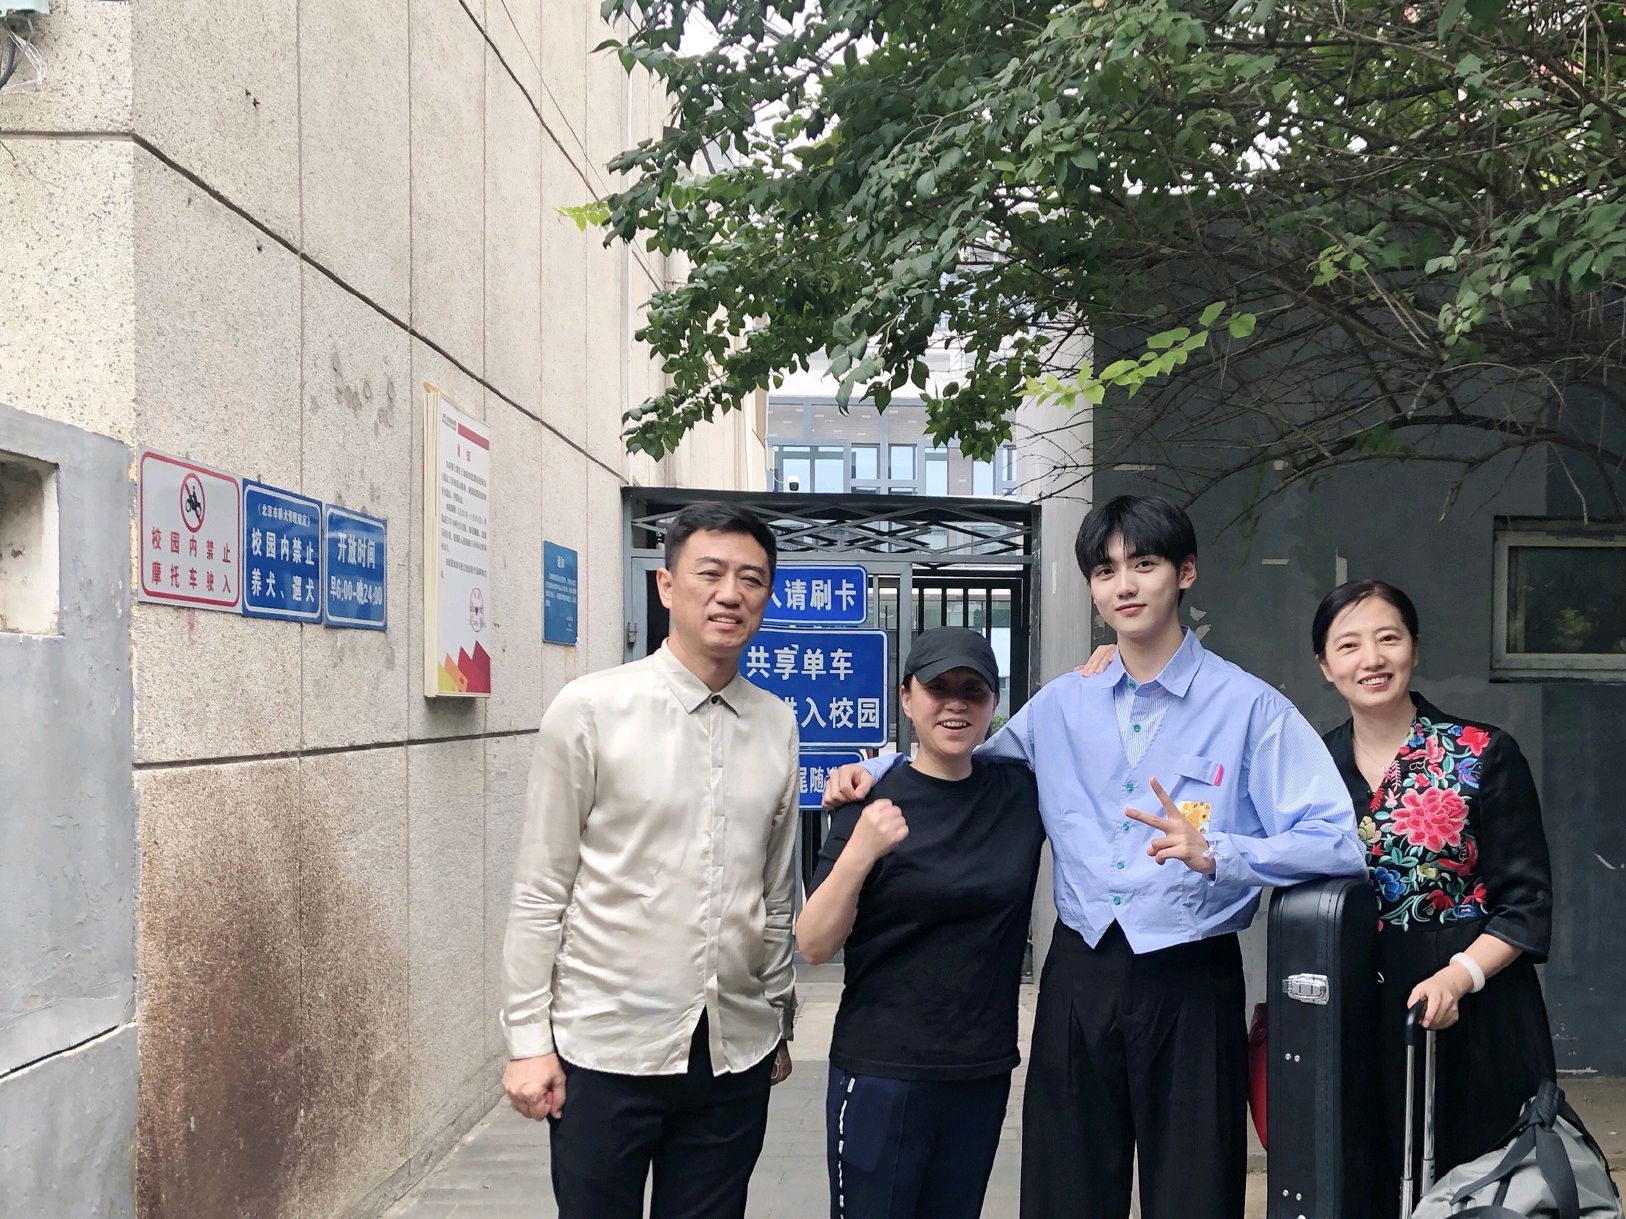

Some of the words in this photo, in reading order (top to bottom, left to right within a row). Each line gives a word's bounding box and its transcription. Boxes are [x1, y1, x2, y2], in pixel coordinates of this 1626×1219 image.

[151, 526, 231, 563] 校园内禁止
[252, 527, 314, 565] 校园内禁止
[337, 532, 376, 569] 开放时间
[151, 561, 231, 593] 摩托车驶入
[251, 567, 315, 602] 养犬、遛犬
[746, 645, 854, 681] 共享单车
